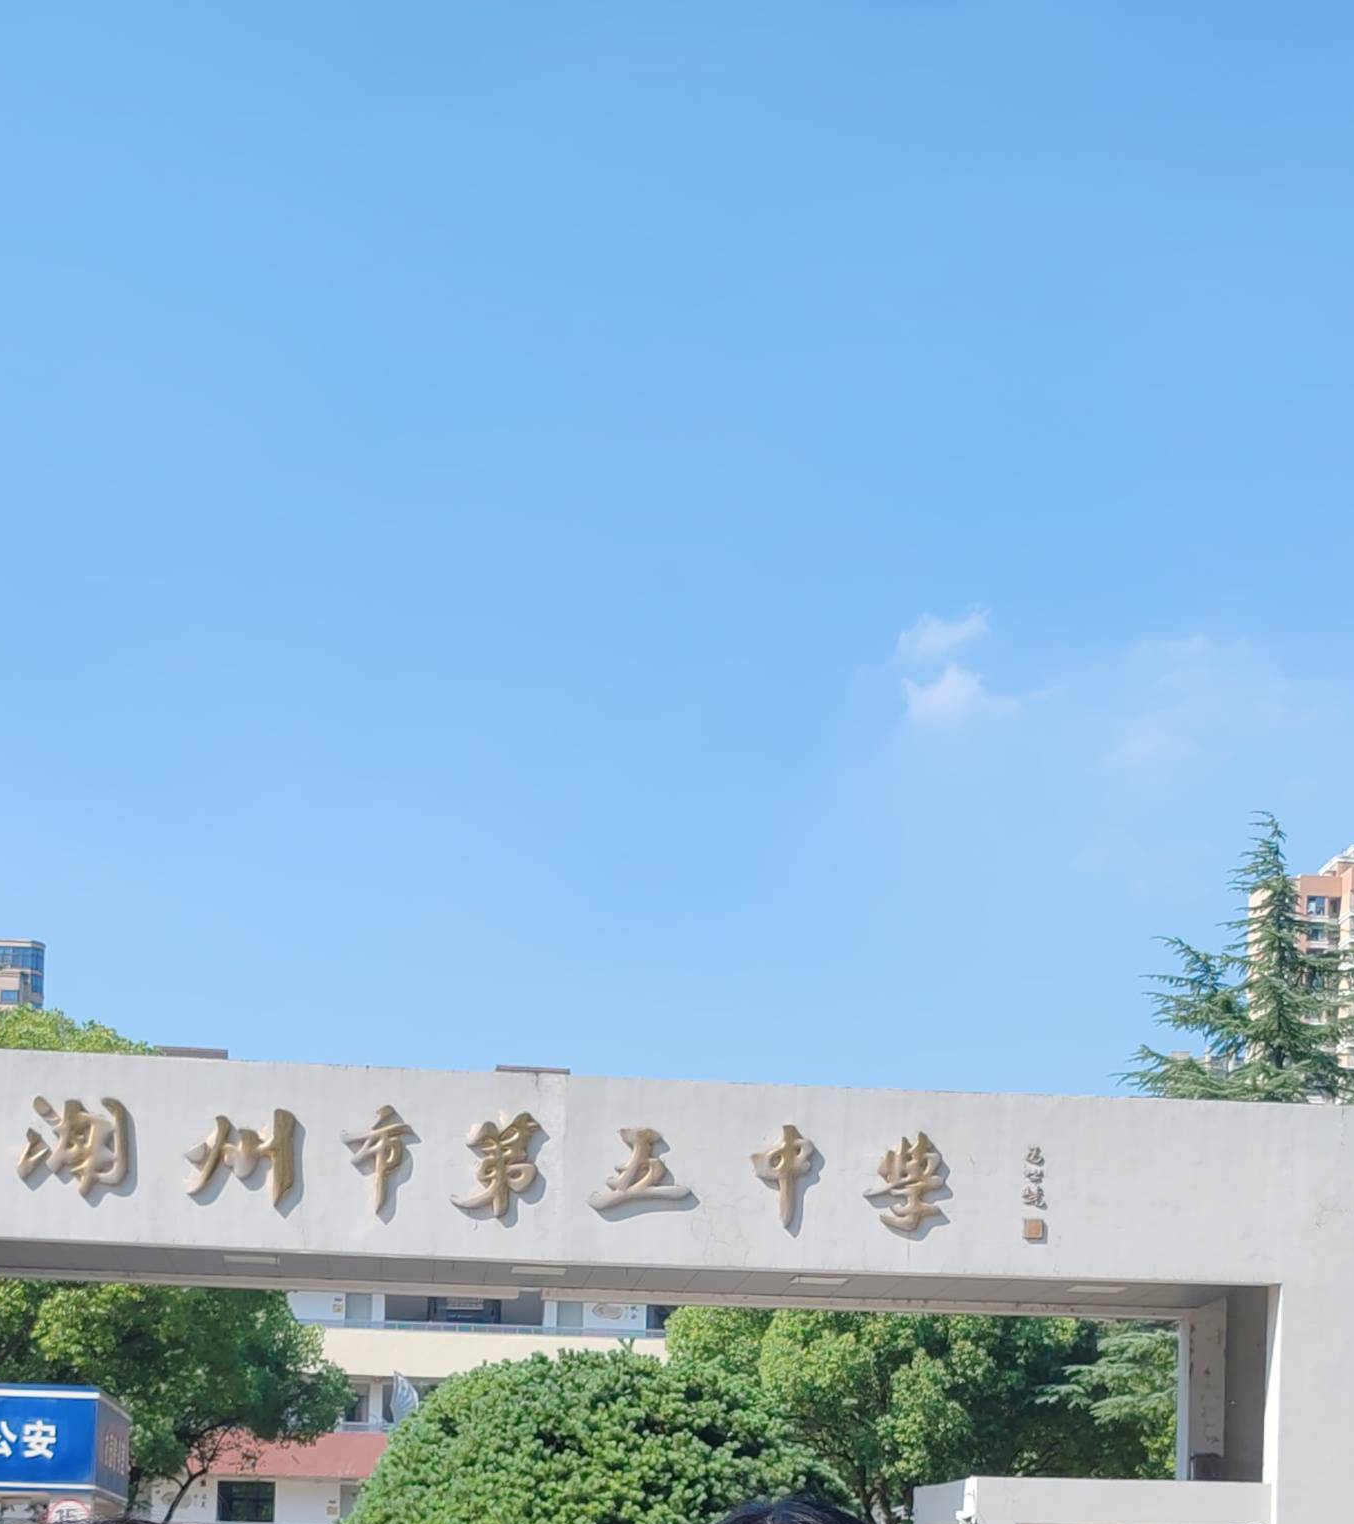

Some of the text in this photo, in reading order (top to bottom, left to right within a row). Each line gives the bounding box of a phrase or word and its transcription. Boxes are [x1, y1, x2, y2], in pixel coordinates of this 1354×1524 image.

[16, 1094, 949, 1234] 湖州市第五中学
